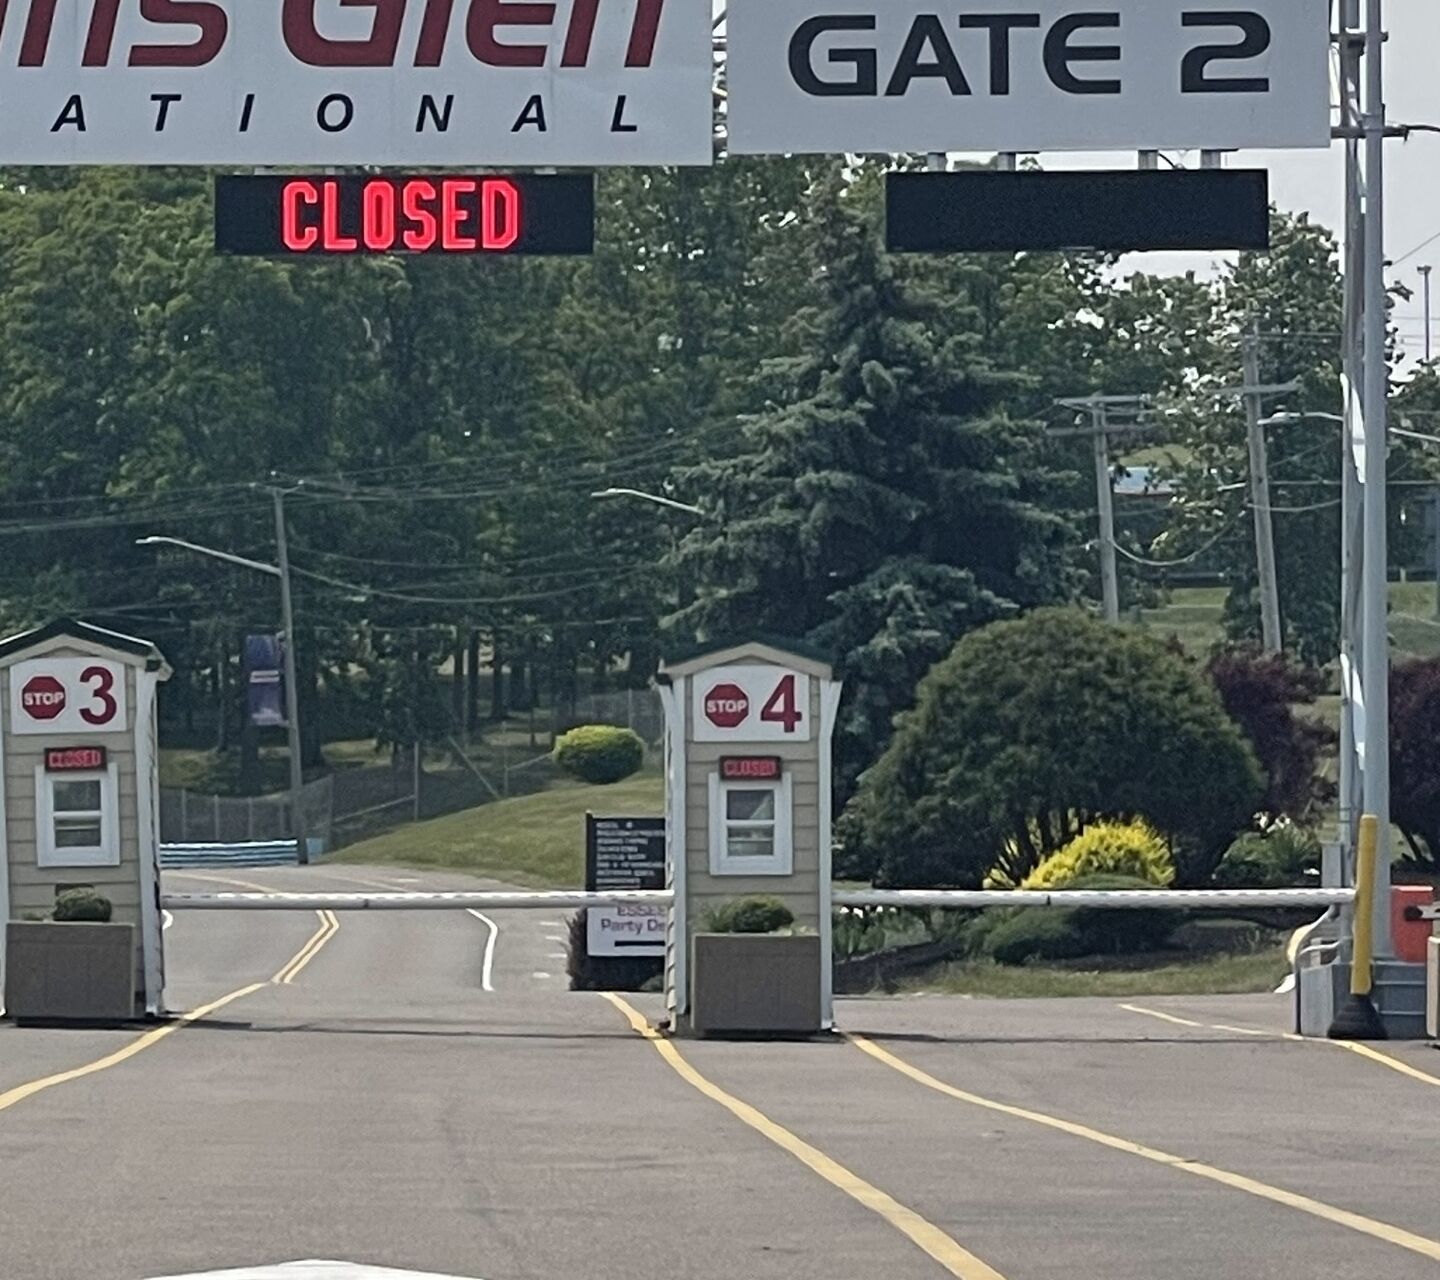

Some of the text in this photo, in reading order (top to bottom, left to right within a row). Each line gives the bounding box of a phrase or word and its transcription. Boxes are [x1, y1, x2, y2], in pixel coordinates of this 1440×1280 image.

[788, 10, 1271, 97] GATE 2
[282, 181, 519, 250] CLOSED
[23, 666, 117, 725] STOP 3
[706, 674, 802, 733] STOP 4
[601, 918, 665, 935] Party De
